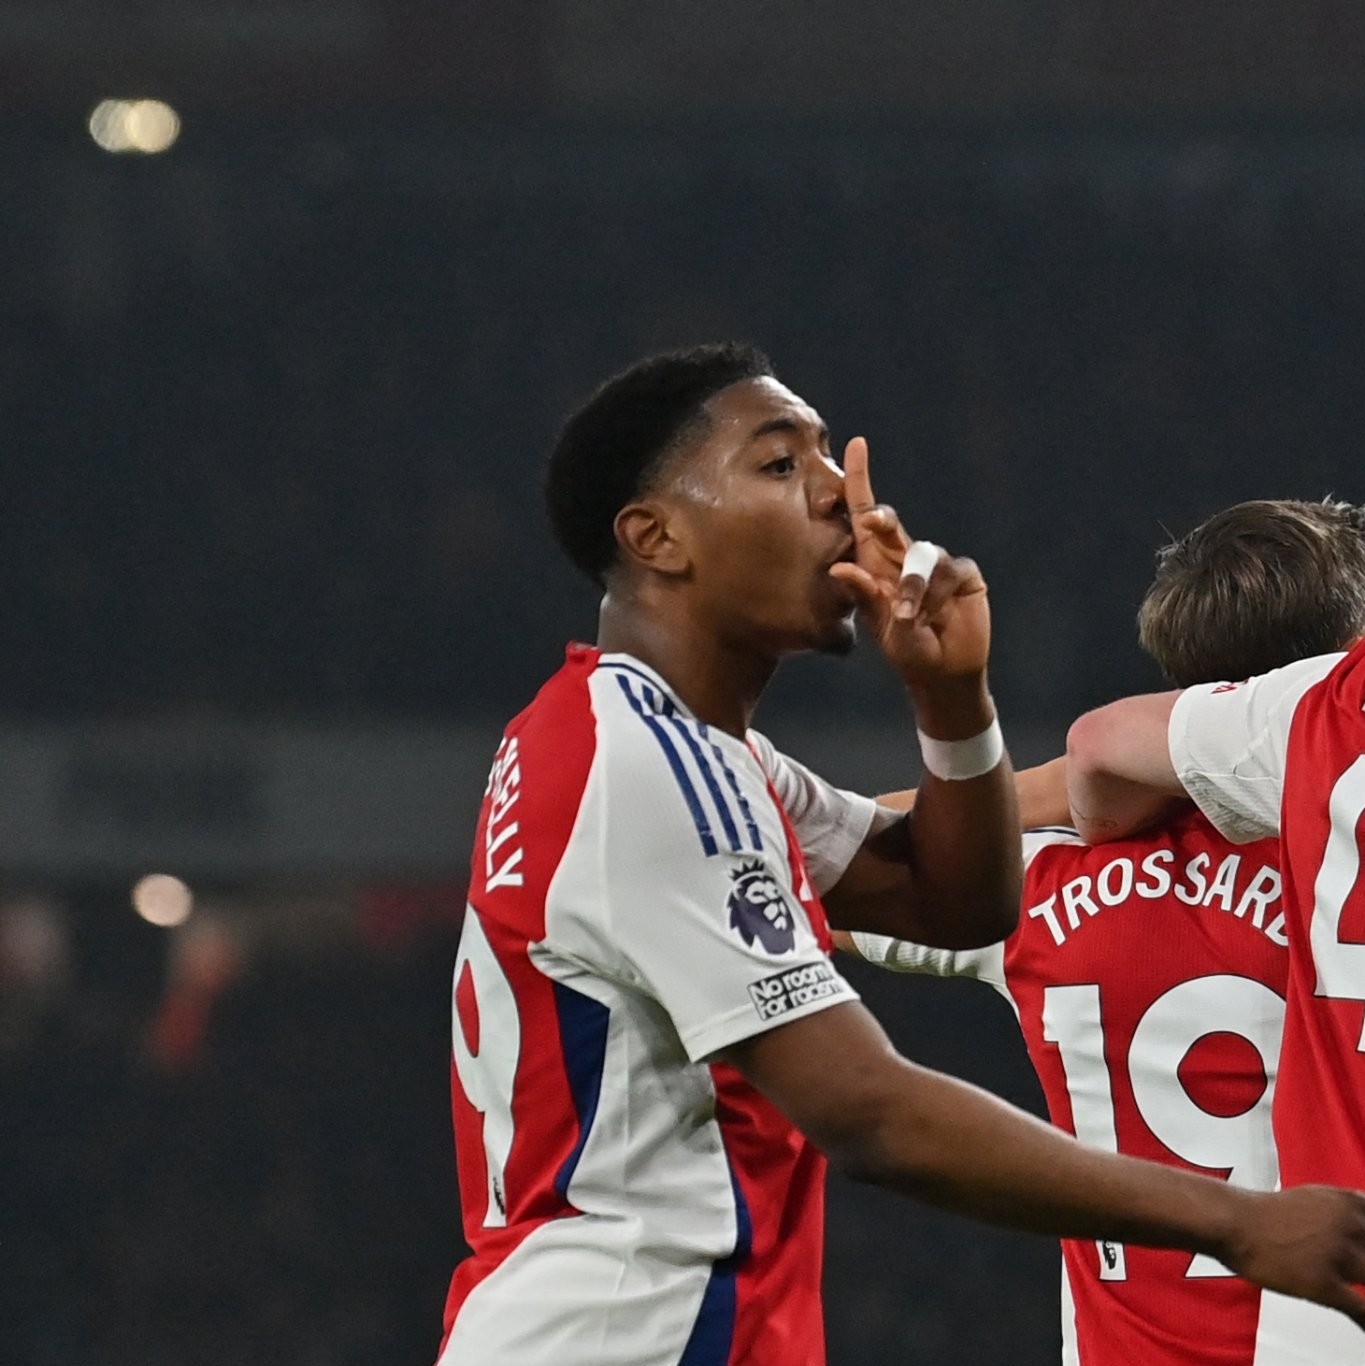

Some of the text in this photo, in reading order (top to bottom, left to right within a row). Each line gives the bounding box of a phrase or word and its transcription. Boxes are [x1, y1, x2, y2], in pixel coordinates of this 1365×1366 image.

[749, 963, 835, 1003] No room
[1042, 974, 1287, 1281] 19
